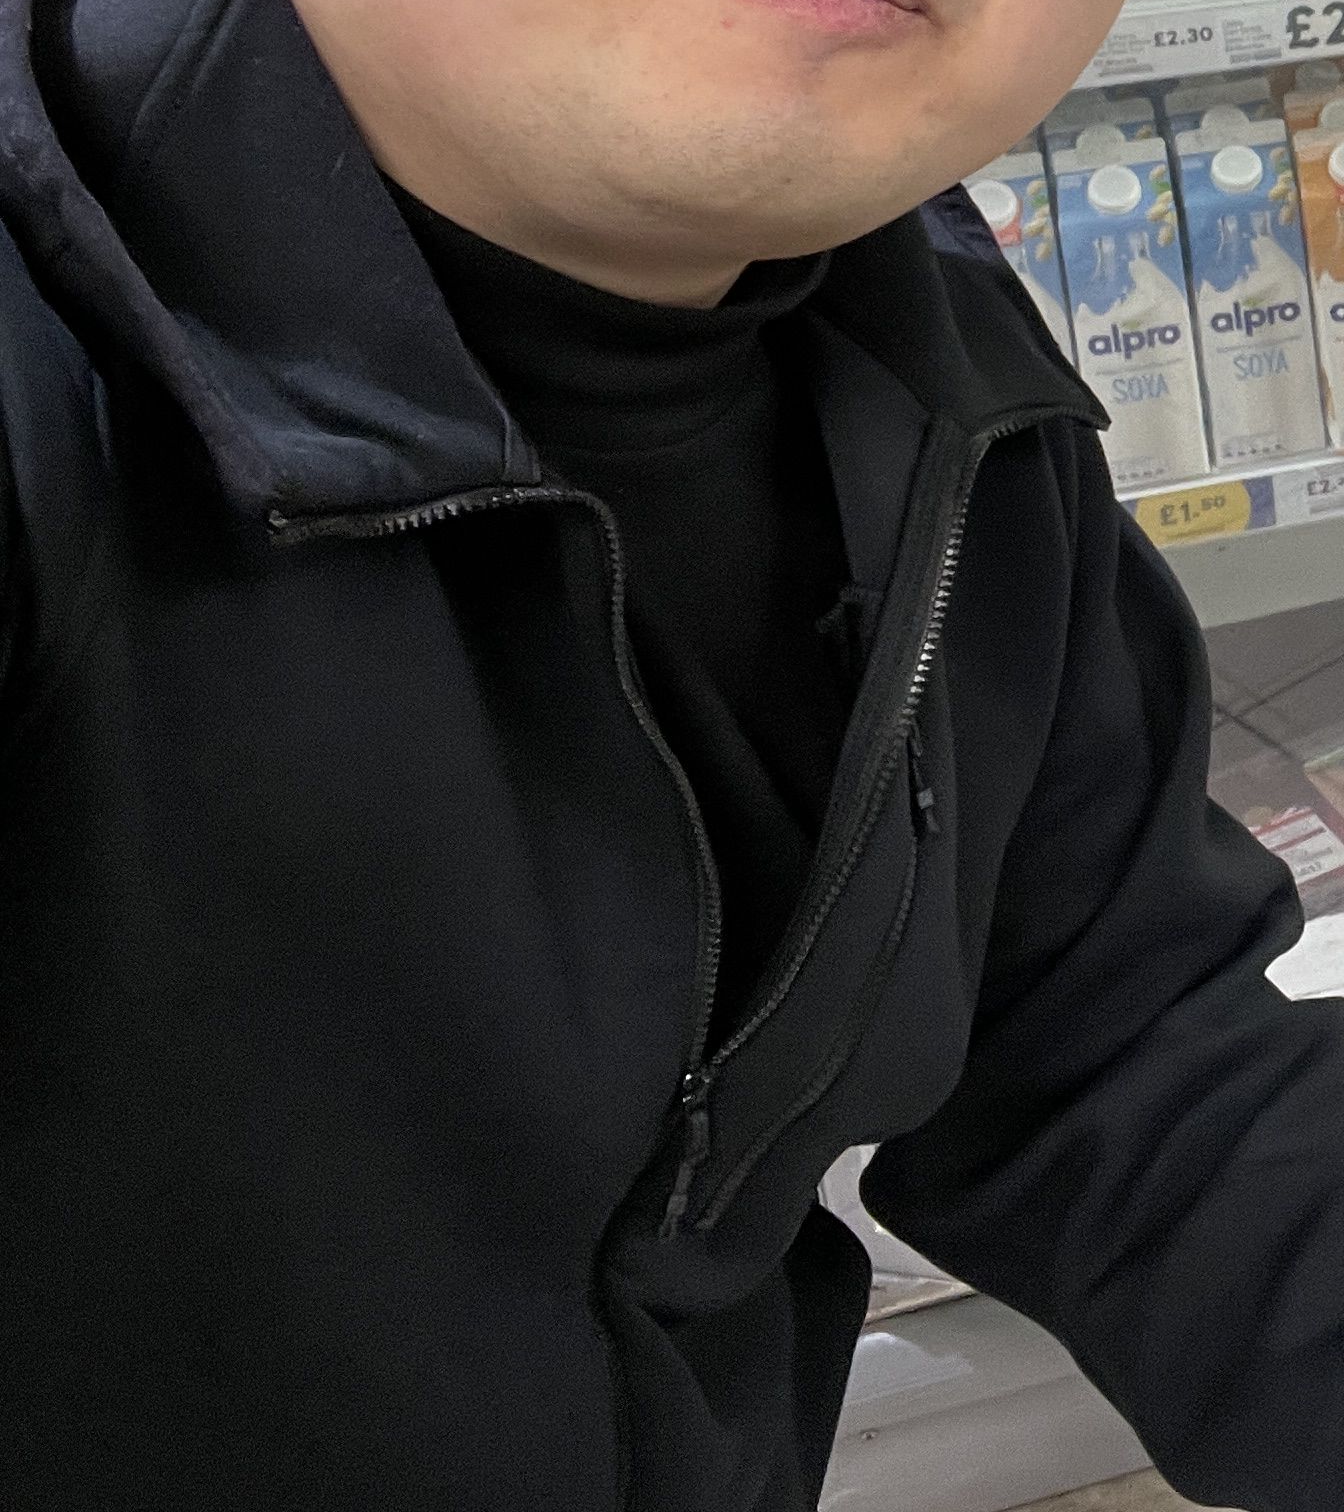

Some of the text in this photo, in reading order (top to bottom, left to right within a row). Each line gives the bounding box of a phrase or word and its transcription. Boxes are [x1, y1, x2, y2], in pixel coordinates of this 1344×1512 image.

[1154, 26, 1213, 48] £2.30
[1211, 300, 1300, 337] alpro
[1088, 323, 1181, 359] alpro
[1232, 348, 1289, 381] SOYA
[1112, 372, 1170, 404] SOYA
